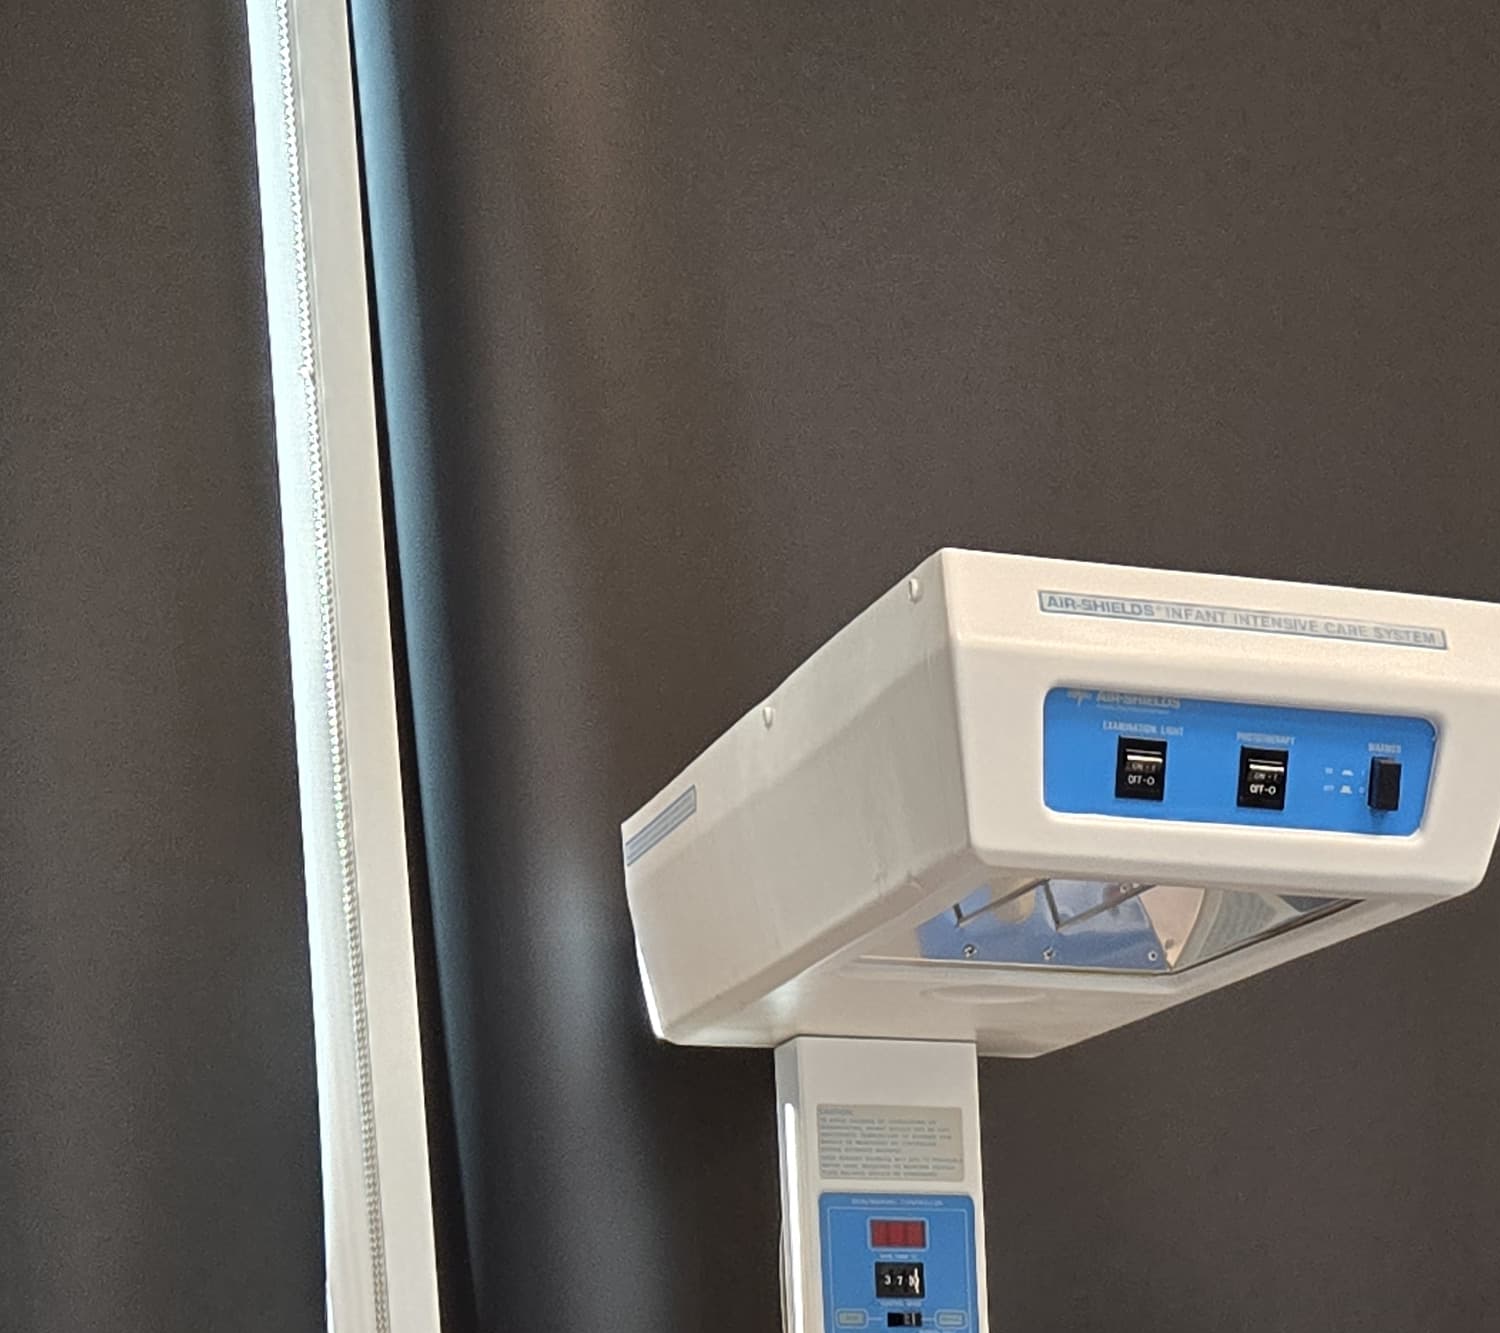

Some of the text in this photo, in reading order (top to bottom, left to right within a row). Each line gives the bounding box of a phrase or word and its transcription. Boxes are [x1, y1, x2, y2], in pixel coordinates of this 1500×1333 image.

[1165, 606, 1226, 625] INFANT
[1233, 611, 1320, 633] INTENSIVE
[1324, 621, 1369, 638] CARE
[1373, 626, 1436, 645] SYSTEM
[1160, 725, 1185, 736] LIGHT
